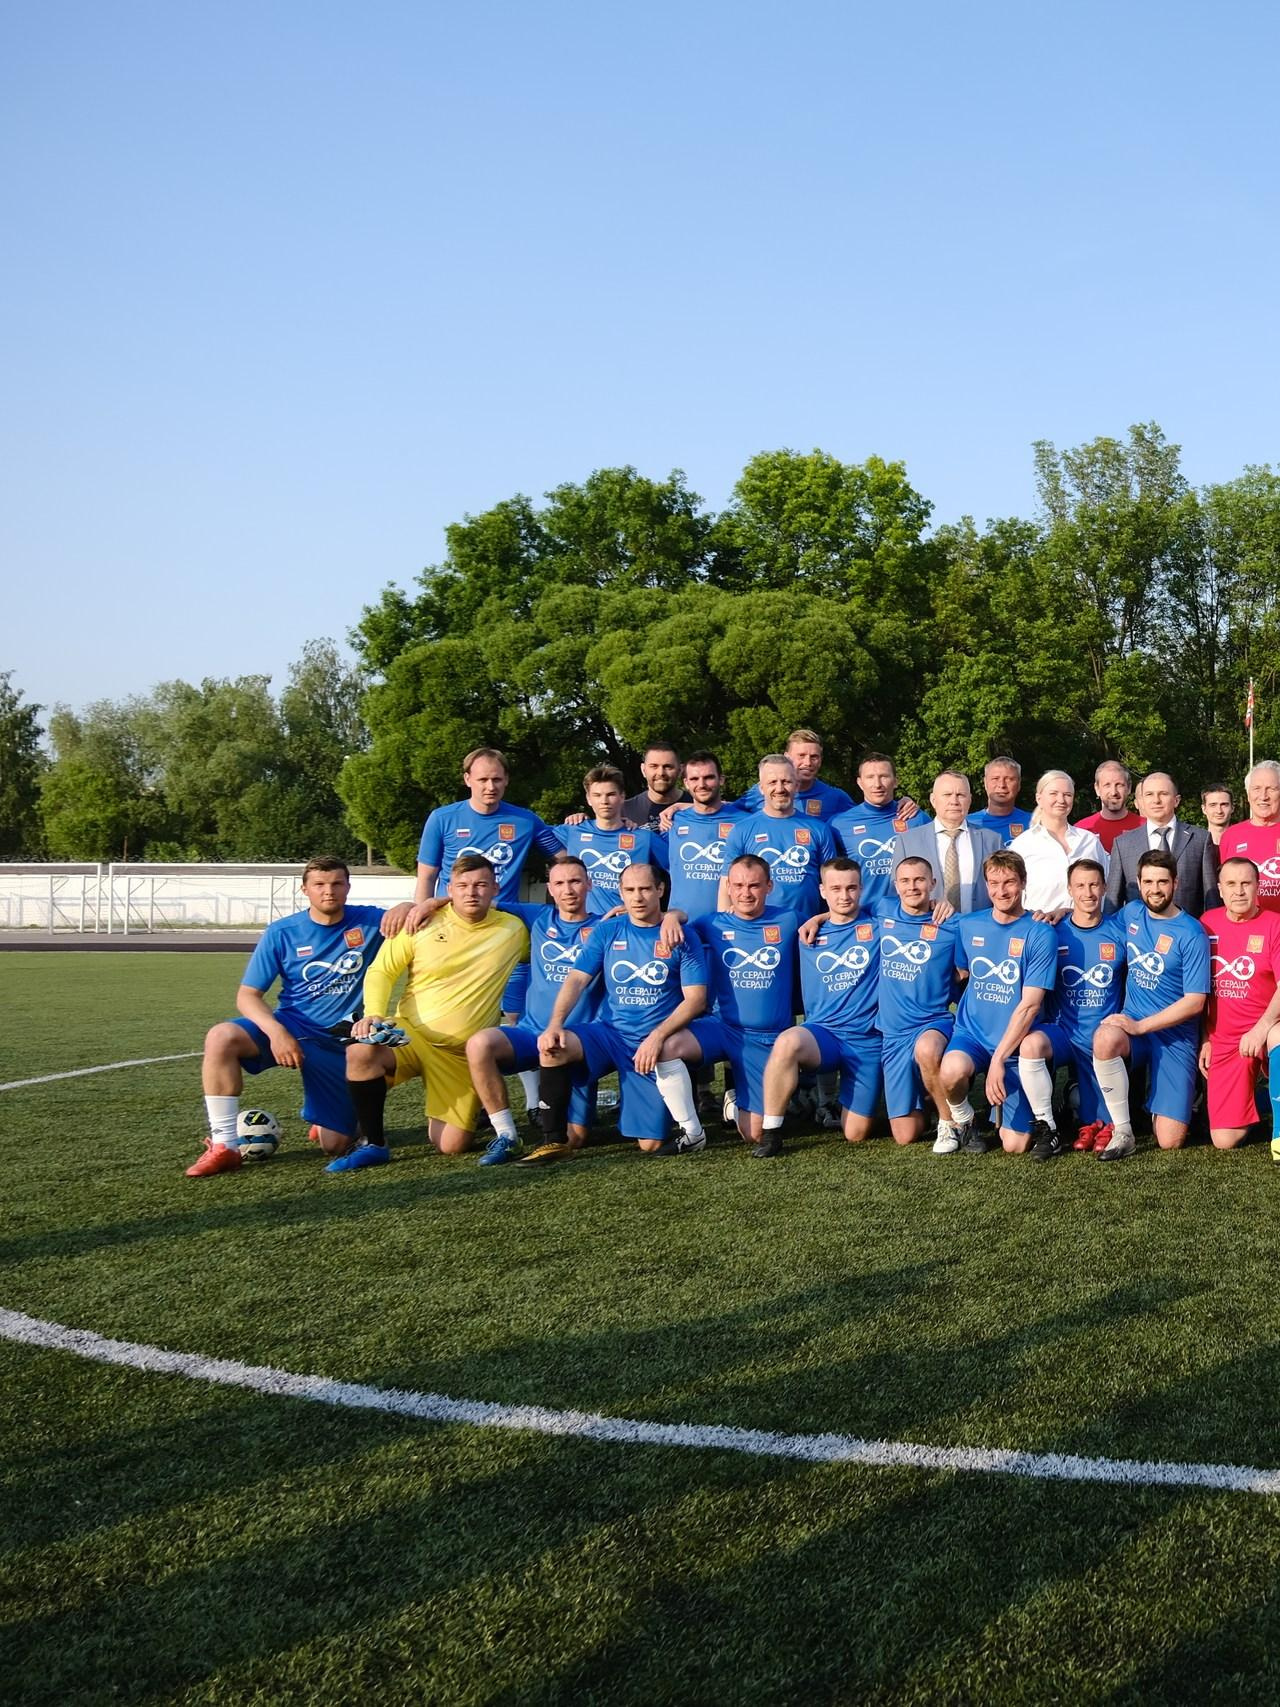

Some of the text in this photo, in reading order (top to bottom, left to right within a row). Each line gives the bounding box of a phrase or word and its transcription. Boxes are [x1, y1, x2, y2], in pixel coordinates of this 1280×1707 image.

[684, 863, 694, 871] ОТ
[866, 859, 876, 868] ОТ
[692, 871, 720, 881] СЕРДЦУ
[544, 963, 555, 972] ОТ
[891, 961, 921, 973] СЕРДЦА
[729, 970, 775, 980] ОТ СЕРДЦА
[823, 970, 865, 983] ОТ СЕРДЦА
[888, 970, 916, 982] СЕРДЦУ
[740, 980, 772, 989] СЕРДЦУ
[974, 981, 1014, 994] ОТ СЕРДЦА
[1219, 980, 1250, 989] СЕРДЦА
[616, 986, 662, 996] ОТ СЕРДЦА
[1219, 990, 1248, 999] СЕРДЦУ
[625, 996, 658, 1005] СЕРДЦУ
[983, 993, 1011, 1004] СЕРДЦУ
